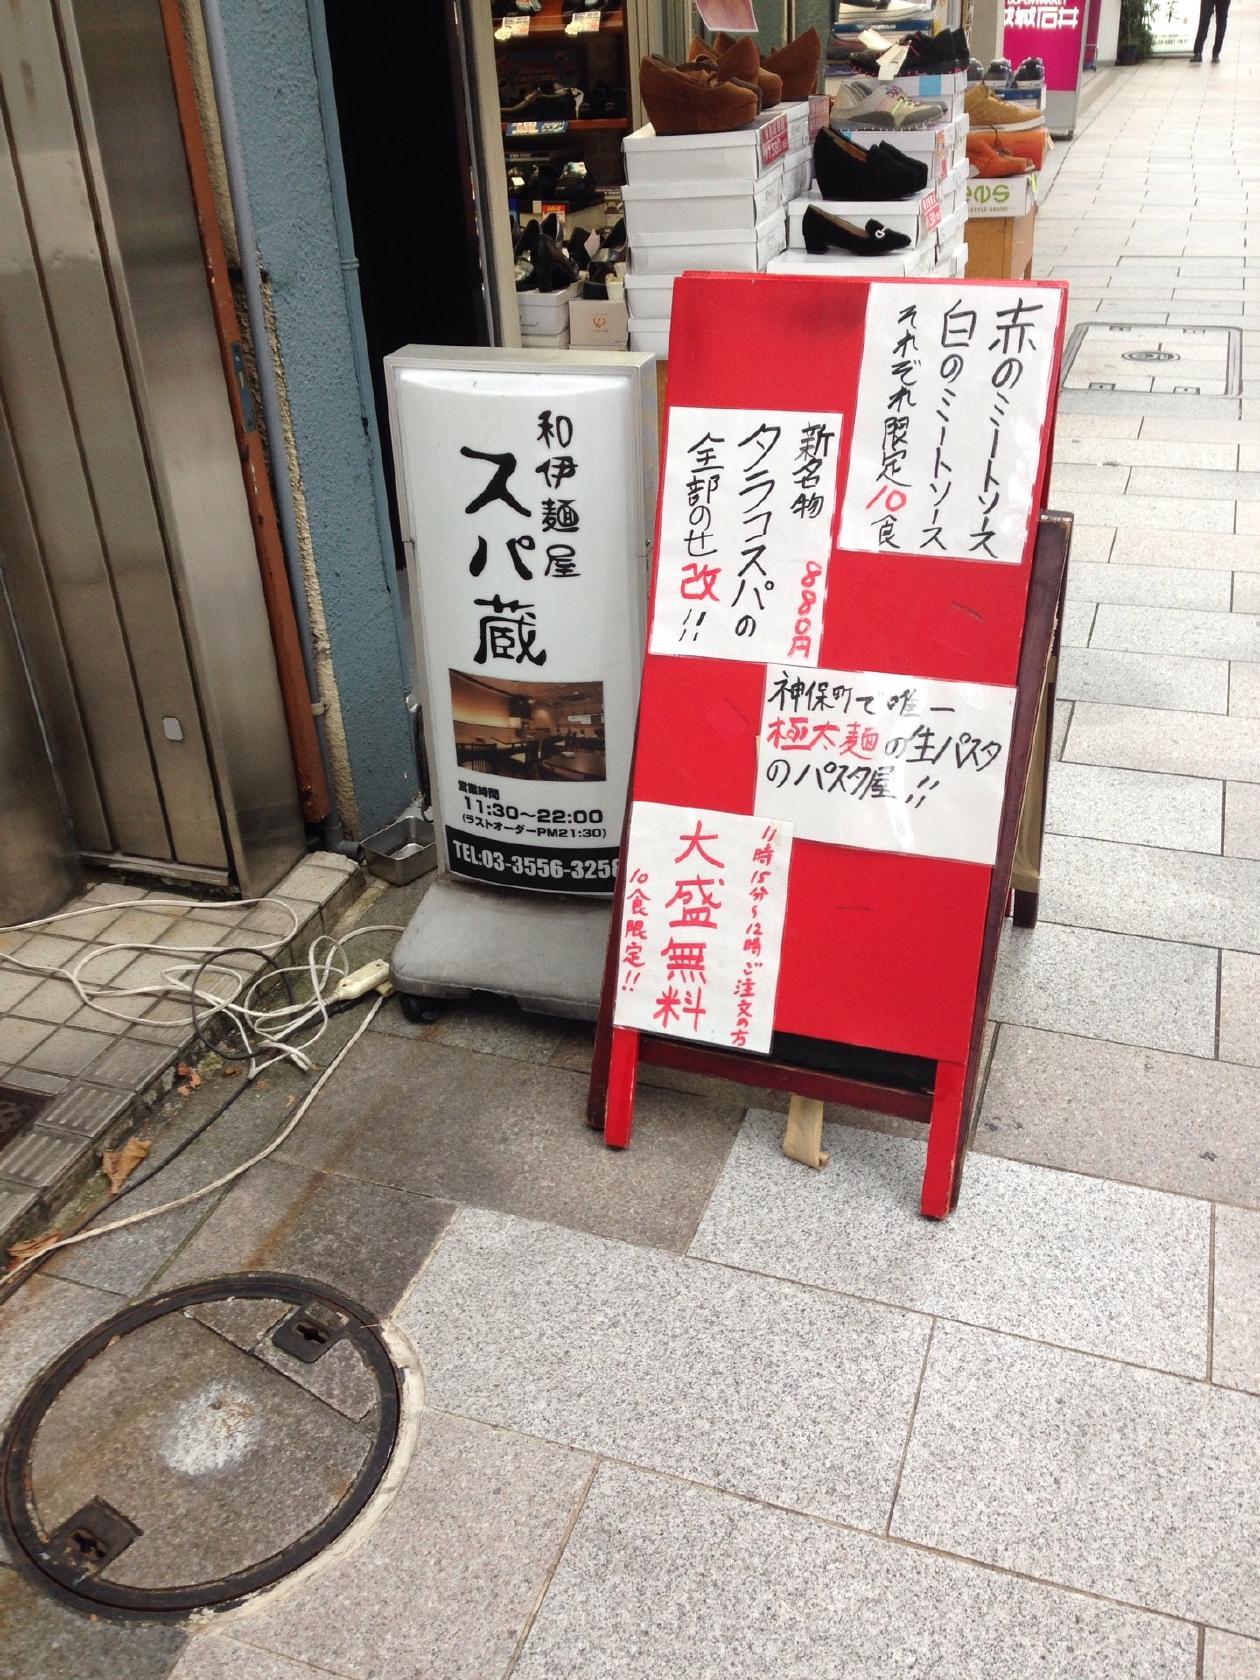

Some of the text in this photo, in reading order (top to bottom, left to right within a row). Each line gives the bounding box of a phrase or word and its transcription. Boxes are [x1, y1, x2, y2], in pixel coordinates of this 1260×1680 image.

[535, 409, 581, 578] 和伊麺屋
[731, 423, 781, 637] タラコスパの
[790, 422, 835, 519] 新名物
[865, 304, 921, 549] それぞれ限定10食
[920, 299, 976, 550] 白のミートソース
[968, 298, 1043, 559] 赤のミートソース
[460, 446, 547, 666] スパ蔵
[458, 780, 500, 800] 営業時間
[462, 813, 607, 839] (ラストオーダーPM21:30)
[622, 868, 651, 992] 10食限定!!
[653, 820, 725, 1032] 大盛無料
